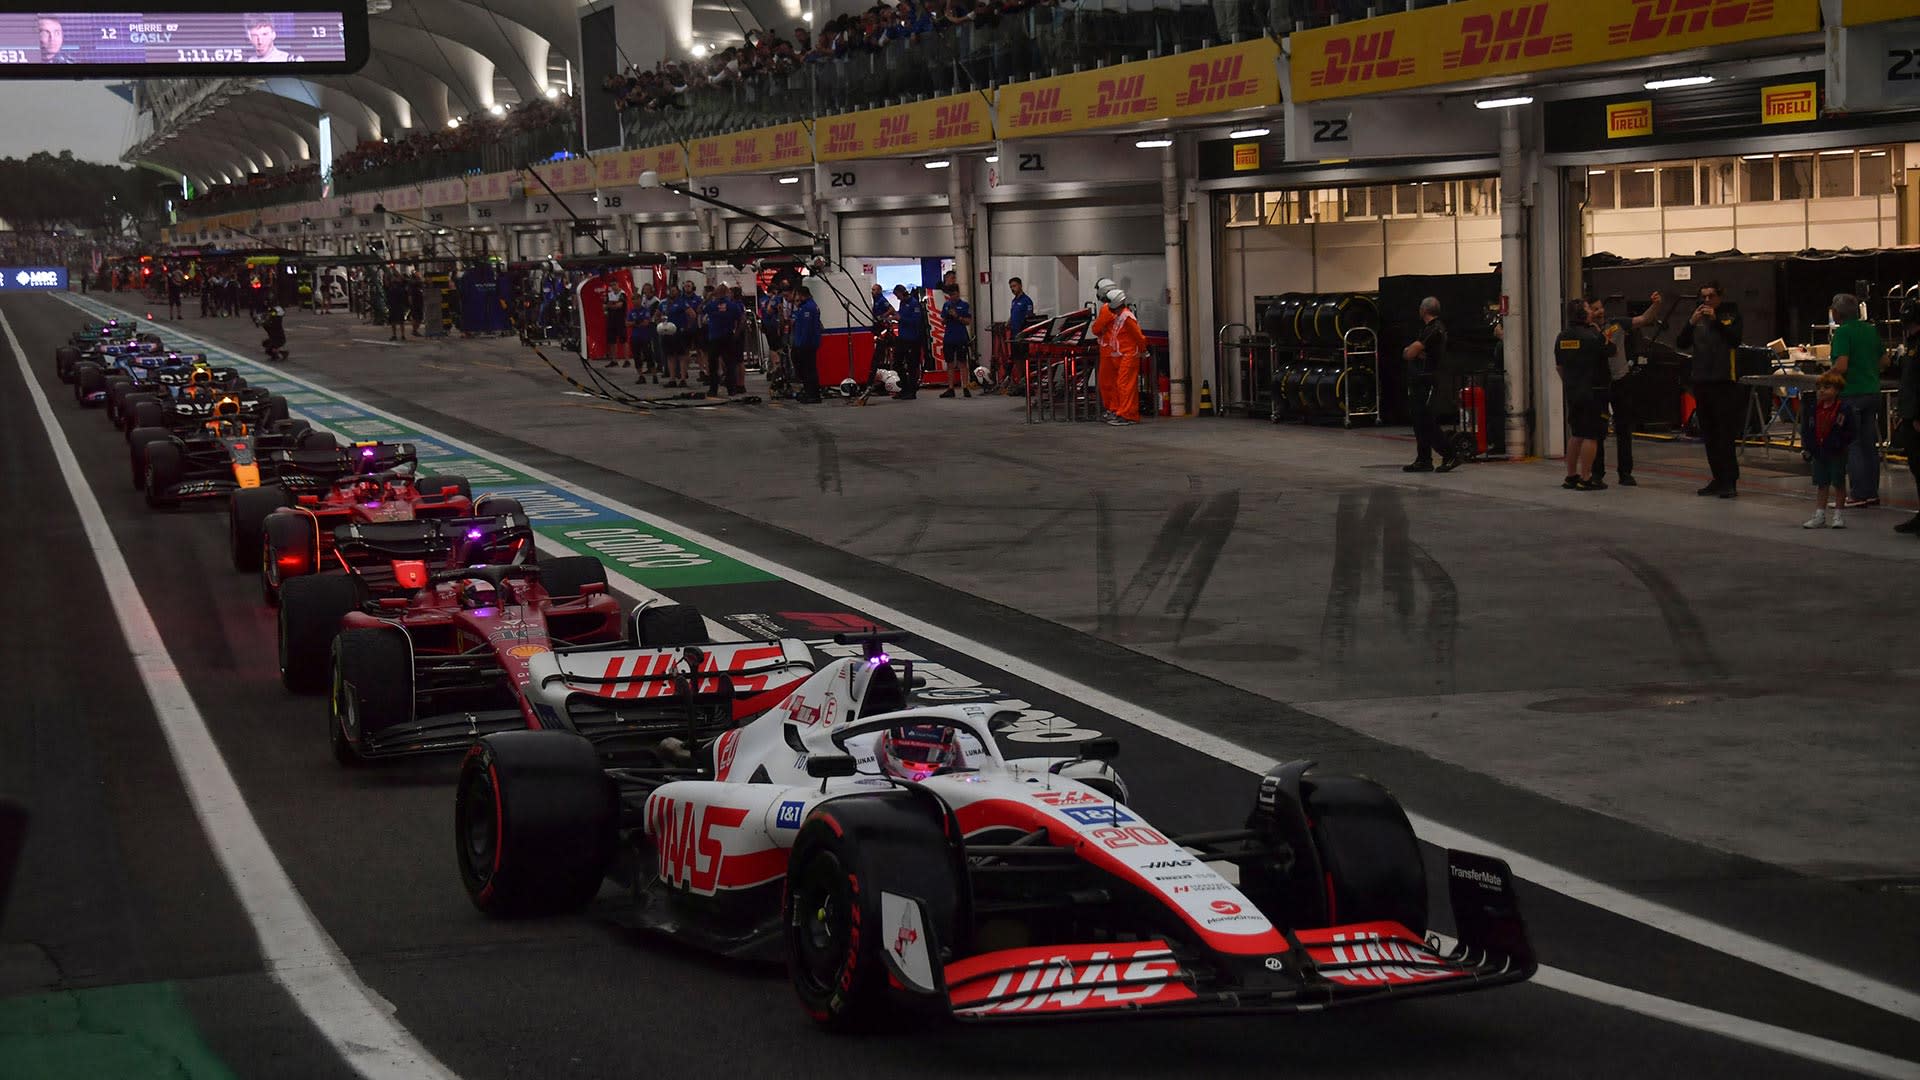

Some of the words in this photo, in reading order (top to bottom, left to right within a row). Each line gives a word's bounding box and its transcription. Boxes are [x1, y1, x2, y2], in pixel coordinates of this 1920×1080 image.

[101, 28, 117, 40] 12
[129, 24, 162, 32] PIERRE
[130, 33, 172, 44] GASLY
[311, 26, 327, 38] 13
[1459, 4, 1553, 68] DHL
[178, 49, 243, 62] 1:11.675
[1323, 30, 1400, 85] DHL
[1888, 49, 1920, 81] 2
[1188, 55, 1246, 104] DHL
[1018, 87, 1062, 126] DHL
[1097, 74, 1147, 118] DHL
[1766, 90, 1812, 116] PIRELLI
[878, 114, 911, 147] DHL
[935, 102, 971, 136] DHL
[1313, 119, 1348, 142] 22
[1610, 107, 1648, 131] PIRELLI
[828, 122, 857, 153] DHL
[1018, 153, 1045, 171] 21
[1236, 148, 1257, 165] PIRELLI
[831, 172, 856, 187] 20
[604, 196, 622, 208] 18
[700, 186, 720, 198] 19
[535, 203, 549, 213] 17
[779, 805, 801, 822] 1&1
[1068, 809, 1124, 821] 1&1
[648, 794, 750, 892] HAAS
[1092, 826, 1169, 850] 20
[1450, 864, 1502, 886] TransferMate
[955, 949, 1179, 1014] HAAS
